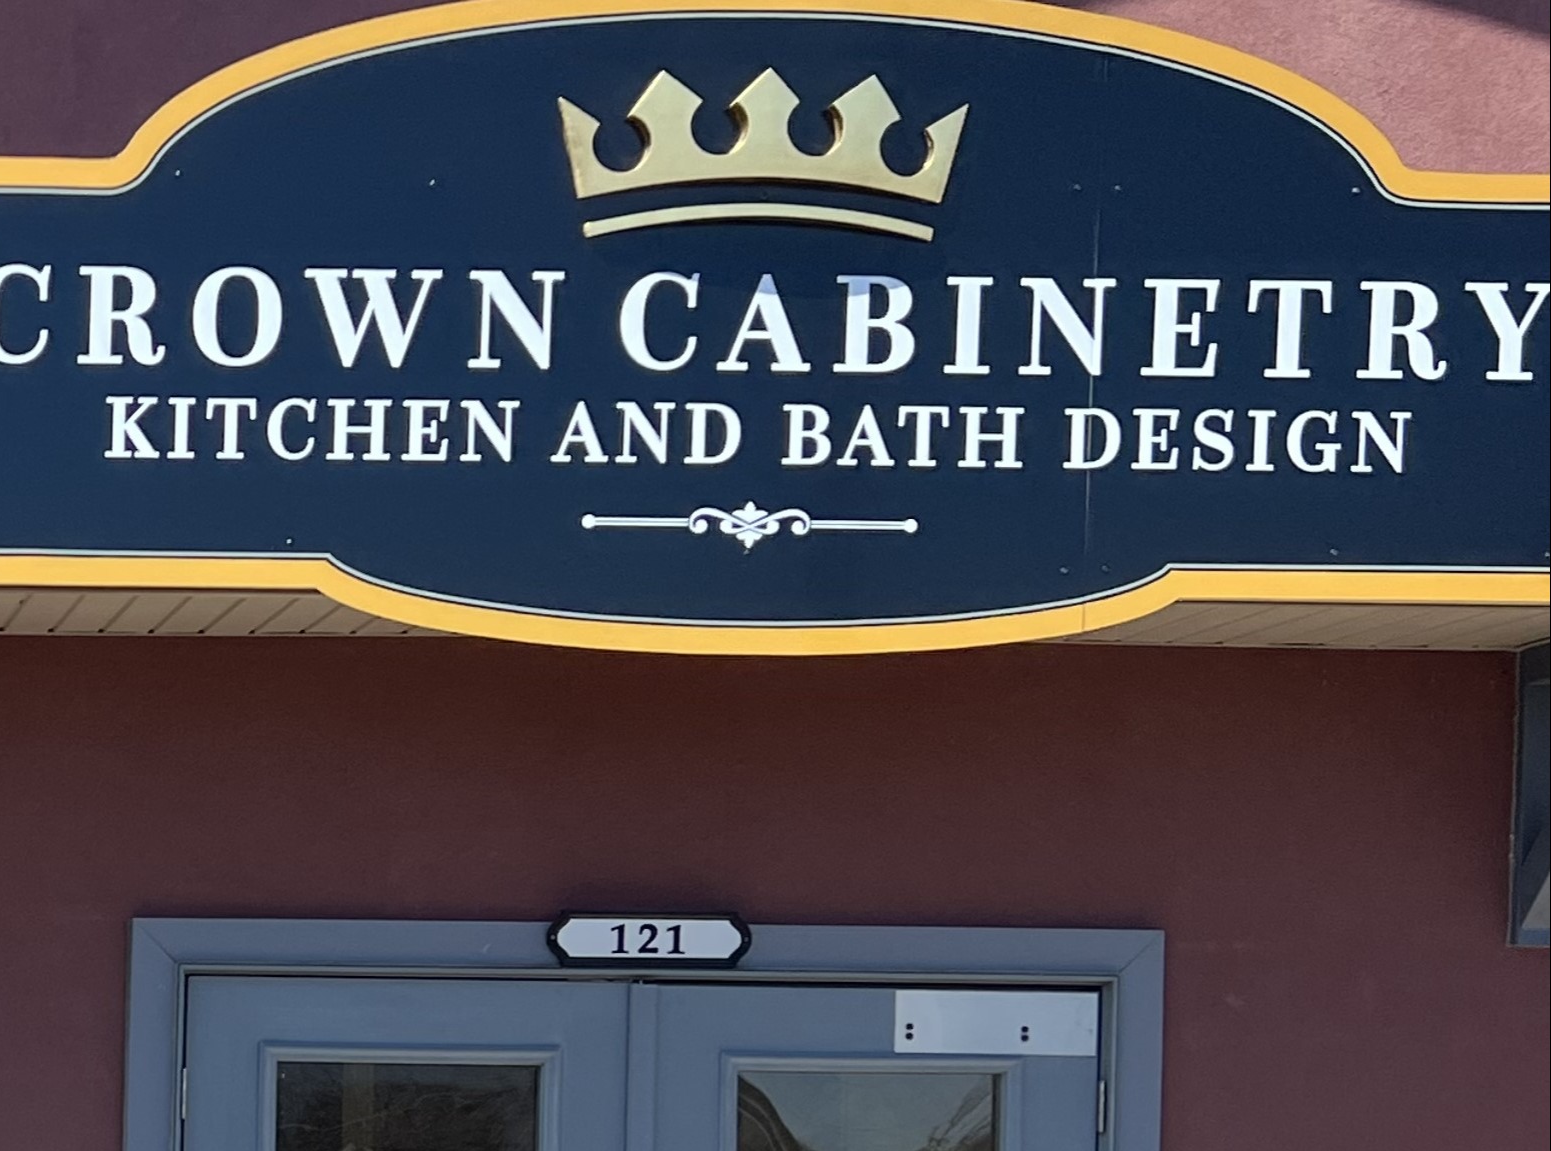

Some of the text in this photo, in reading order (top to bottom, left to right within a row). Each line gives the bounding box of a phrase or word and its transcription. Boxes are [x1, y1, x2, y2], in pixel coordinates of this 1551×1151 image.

[619, 271, 1550, 381] CABINETRY
[103, 395, 1413, 474] KITCHEN AND BATH DESIGN
[610, 923, 686, 955] 121
